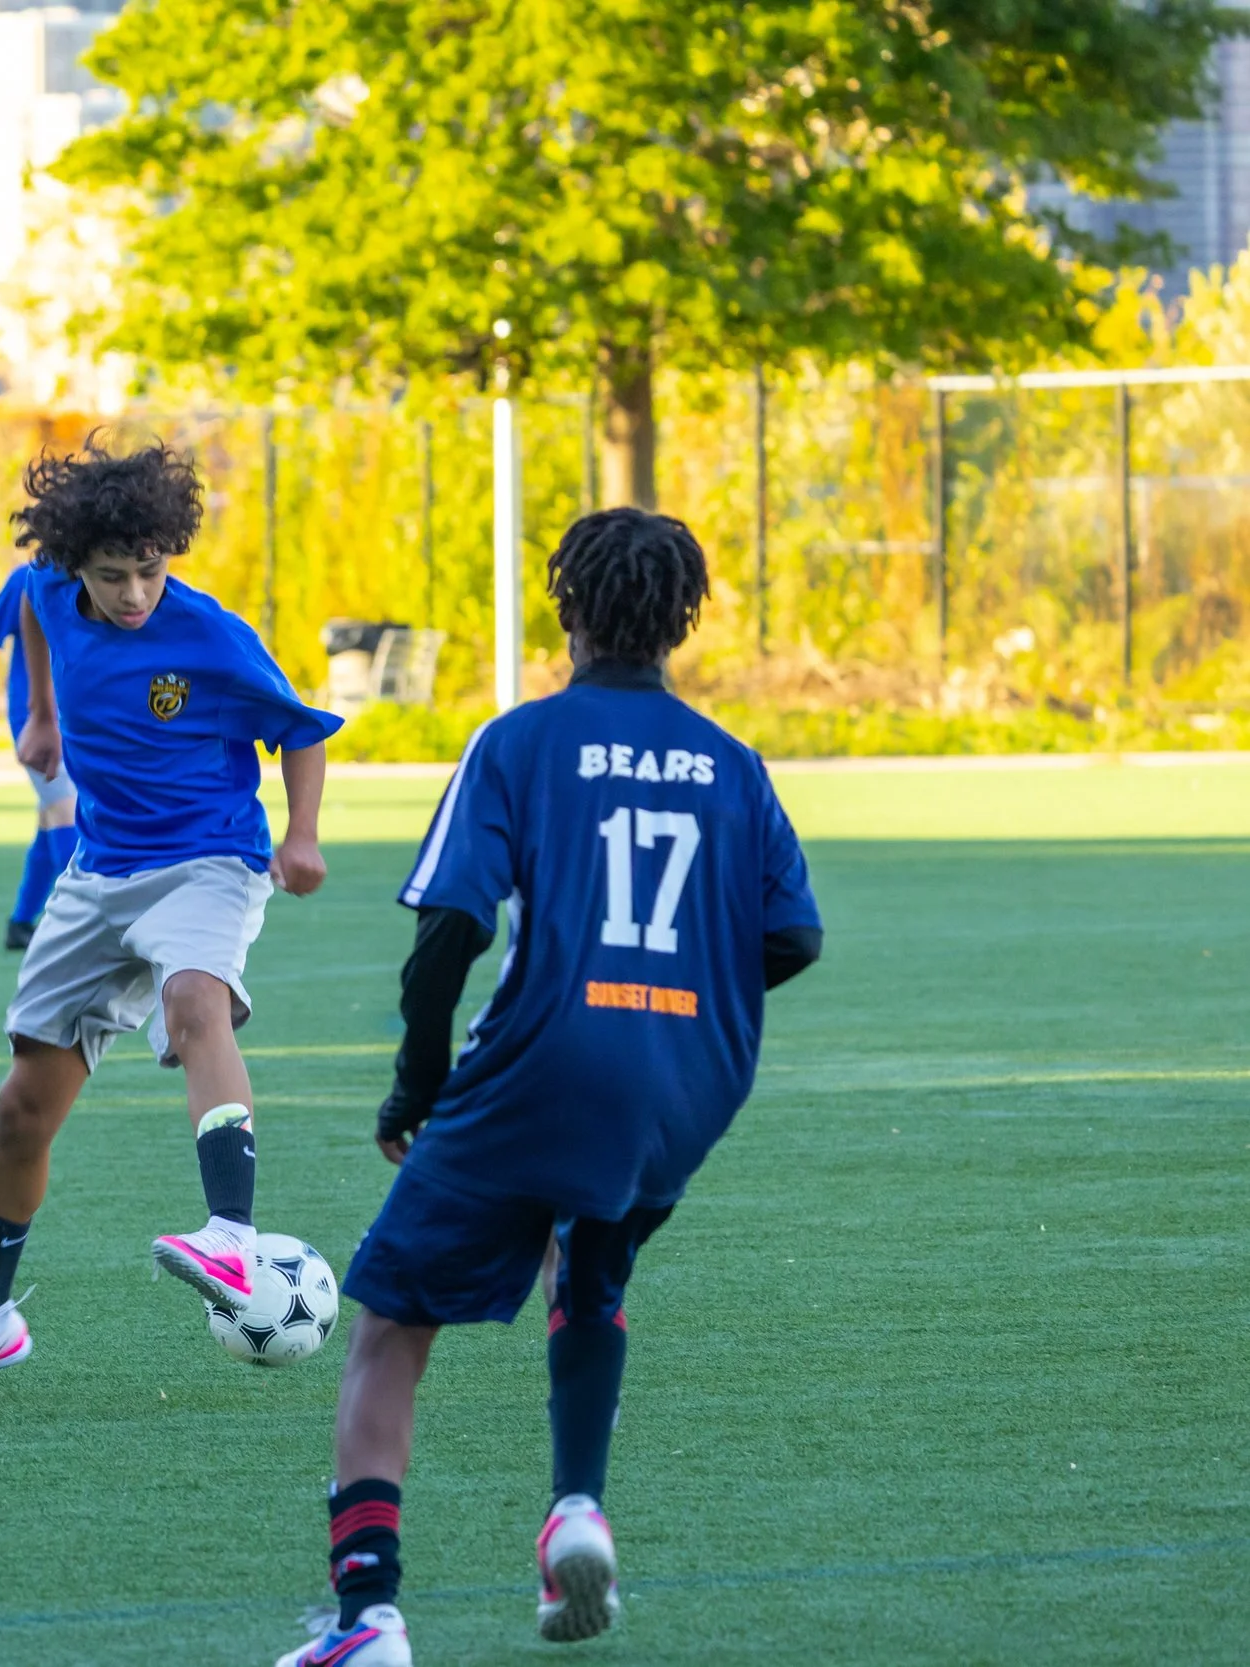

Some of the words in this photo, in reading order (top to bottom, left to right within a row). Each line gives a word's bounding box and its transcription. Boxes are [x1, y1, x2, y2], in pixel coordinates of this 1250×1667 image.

[578, 743, 715, 785] BEARS
[599, 807, 700, 953] 17
[586, 981, 648, 1010] SUNSET
